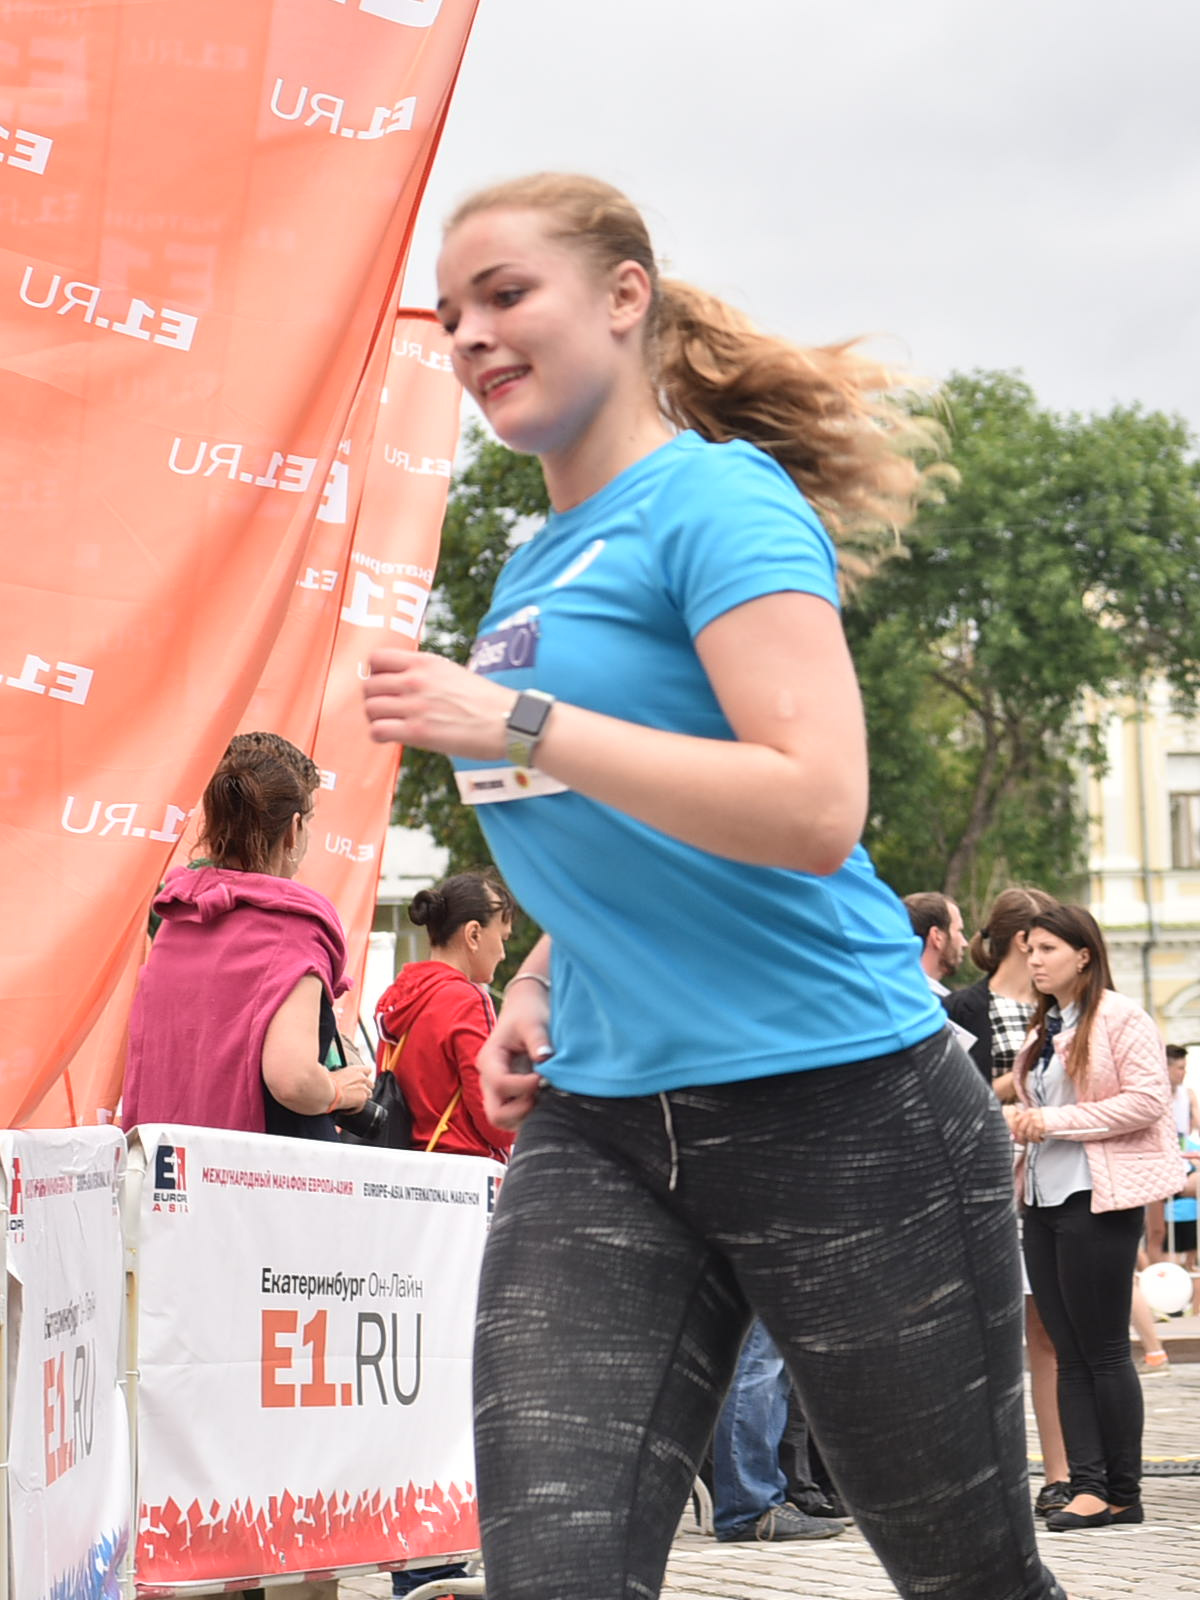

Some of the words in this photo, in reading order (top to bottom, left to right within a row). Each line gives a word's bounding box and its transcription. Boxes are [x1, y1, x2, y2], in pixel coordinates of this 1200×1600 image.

[272, 1174, 307, 1192] МАРАФОН
[262, 1267, 365, 1301] Екатеринбург
[368, 1272, 424, 1298] Он-Лайн
[261, 1310, 422, 1408] E1.RU
[44, 1338, 96, 1487] E1.RU
